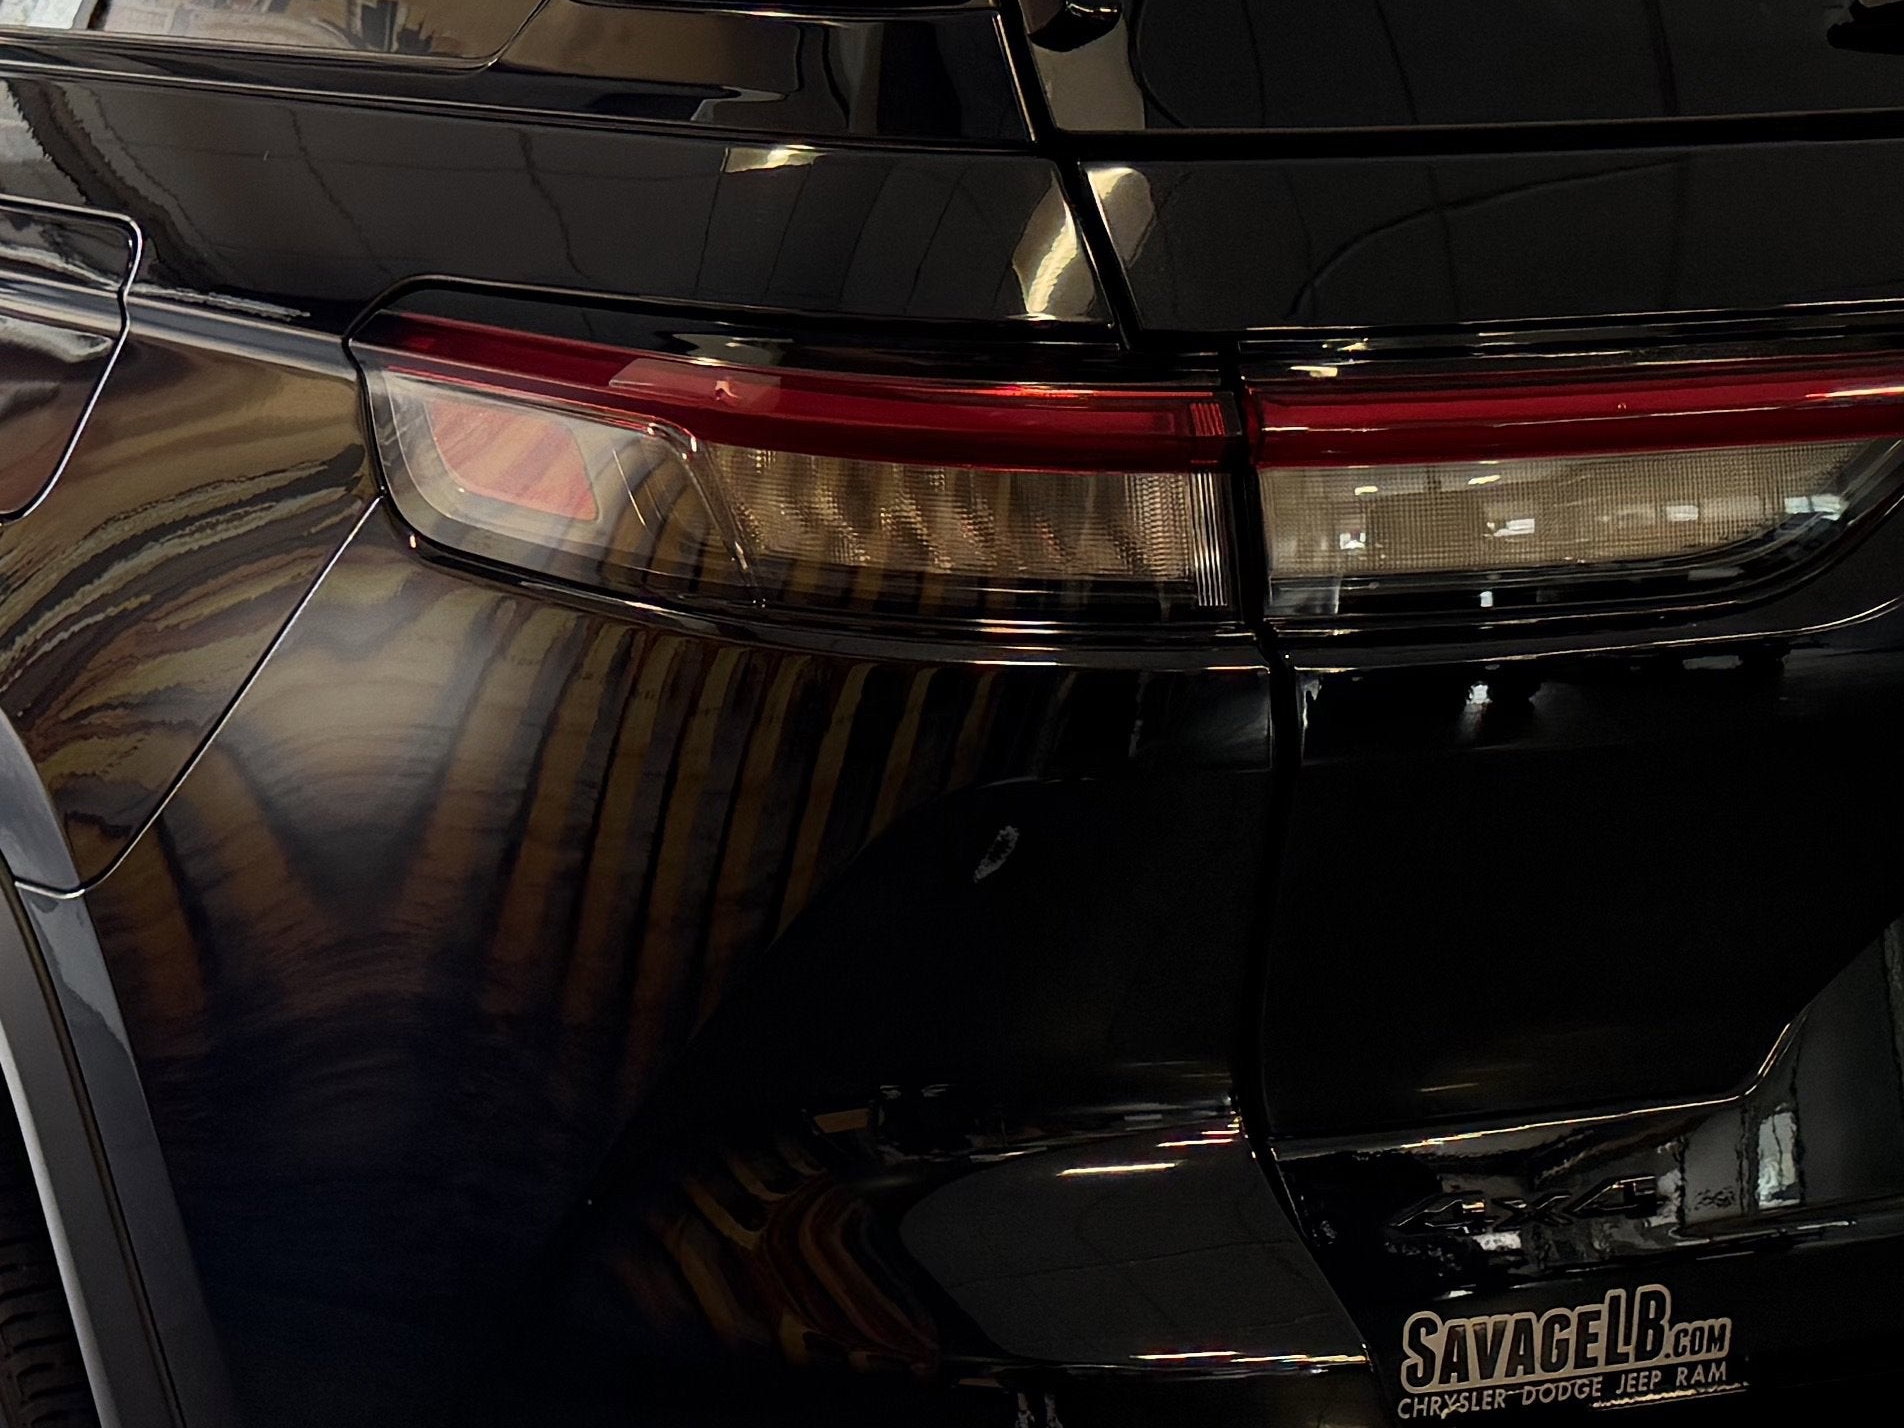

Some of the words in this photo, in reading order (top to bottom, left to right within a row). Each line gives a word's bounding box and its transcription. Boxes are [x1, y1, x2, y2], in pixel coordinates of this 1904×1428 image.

[1397, 1389, 1507, 1421] CHRYSLER
[1522, 1377, 1603, 1407] DODGE
[1615, 1369, 1662, 1396] JEEP
[1676, 1361, 1728, 1387] RAM
